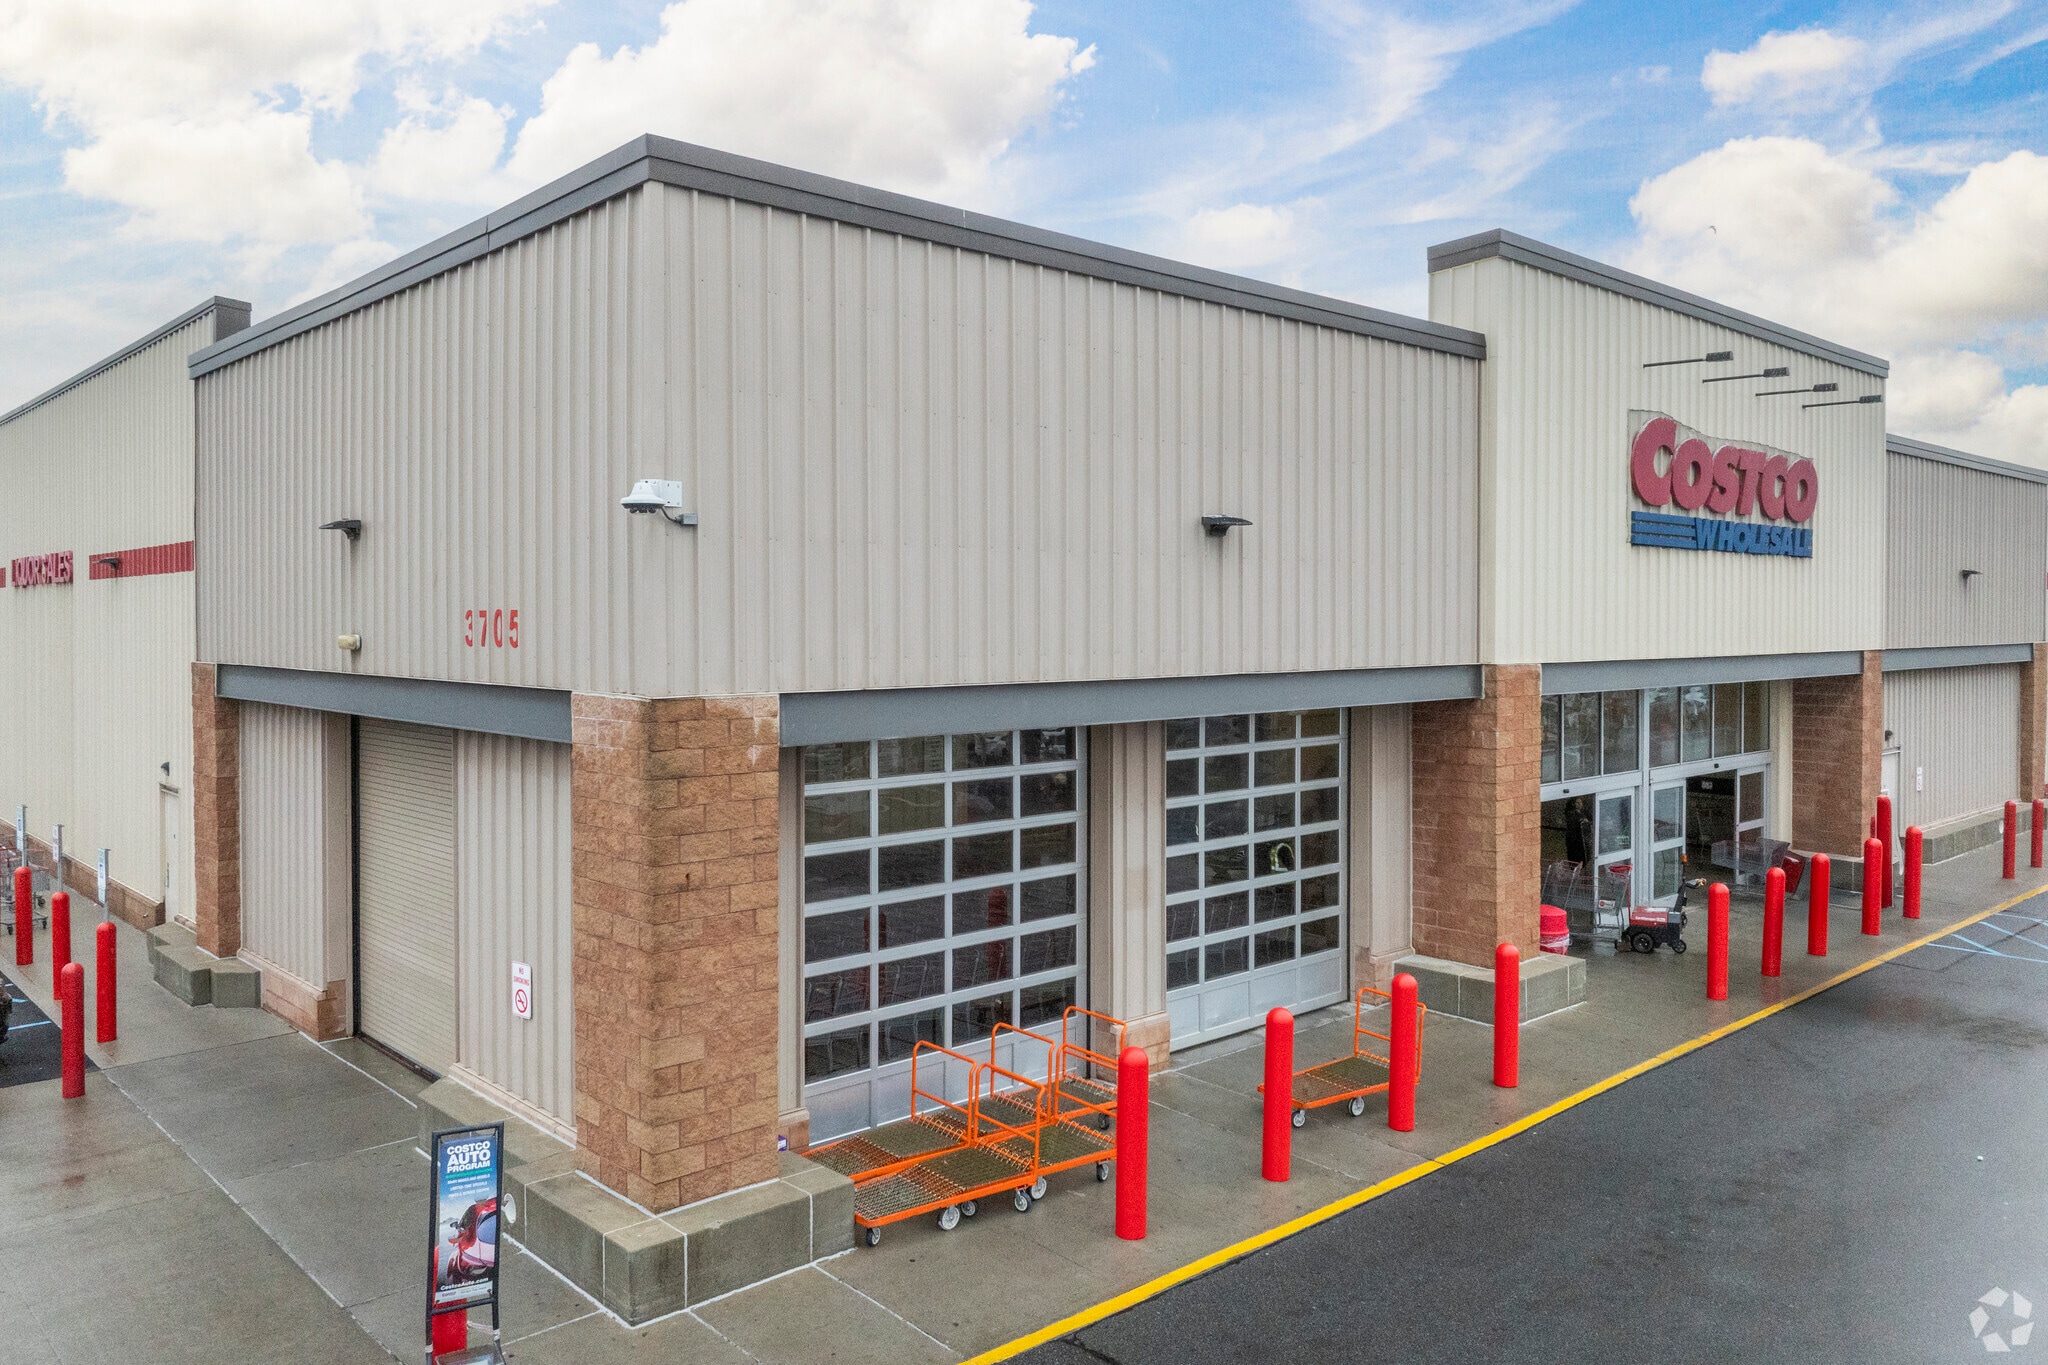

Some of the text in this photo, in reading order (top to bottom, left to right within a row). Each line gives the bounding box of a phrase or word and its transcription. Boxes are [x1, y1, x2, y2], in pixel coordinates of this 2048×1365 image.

[1631, 416, 1818, 524] COSTCO
[1695, 517, 1813, 558] WHOLESALE
[42, 550, 73, 584] SALES
[464, 608, 519, 649] 3705
[447, 1141, 491, 1155] COSTCO
[447, 1149, 491, 1167] AUTO
[447, 1160, 490, 1174] PROGRAM
